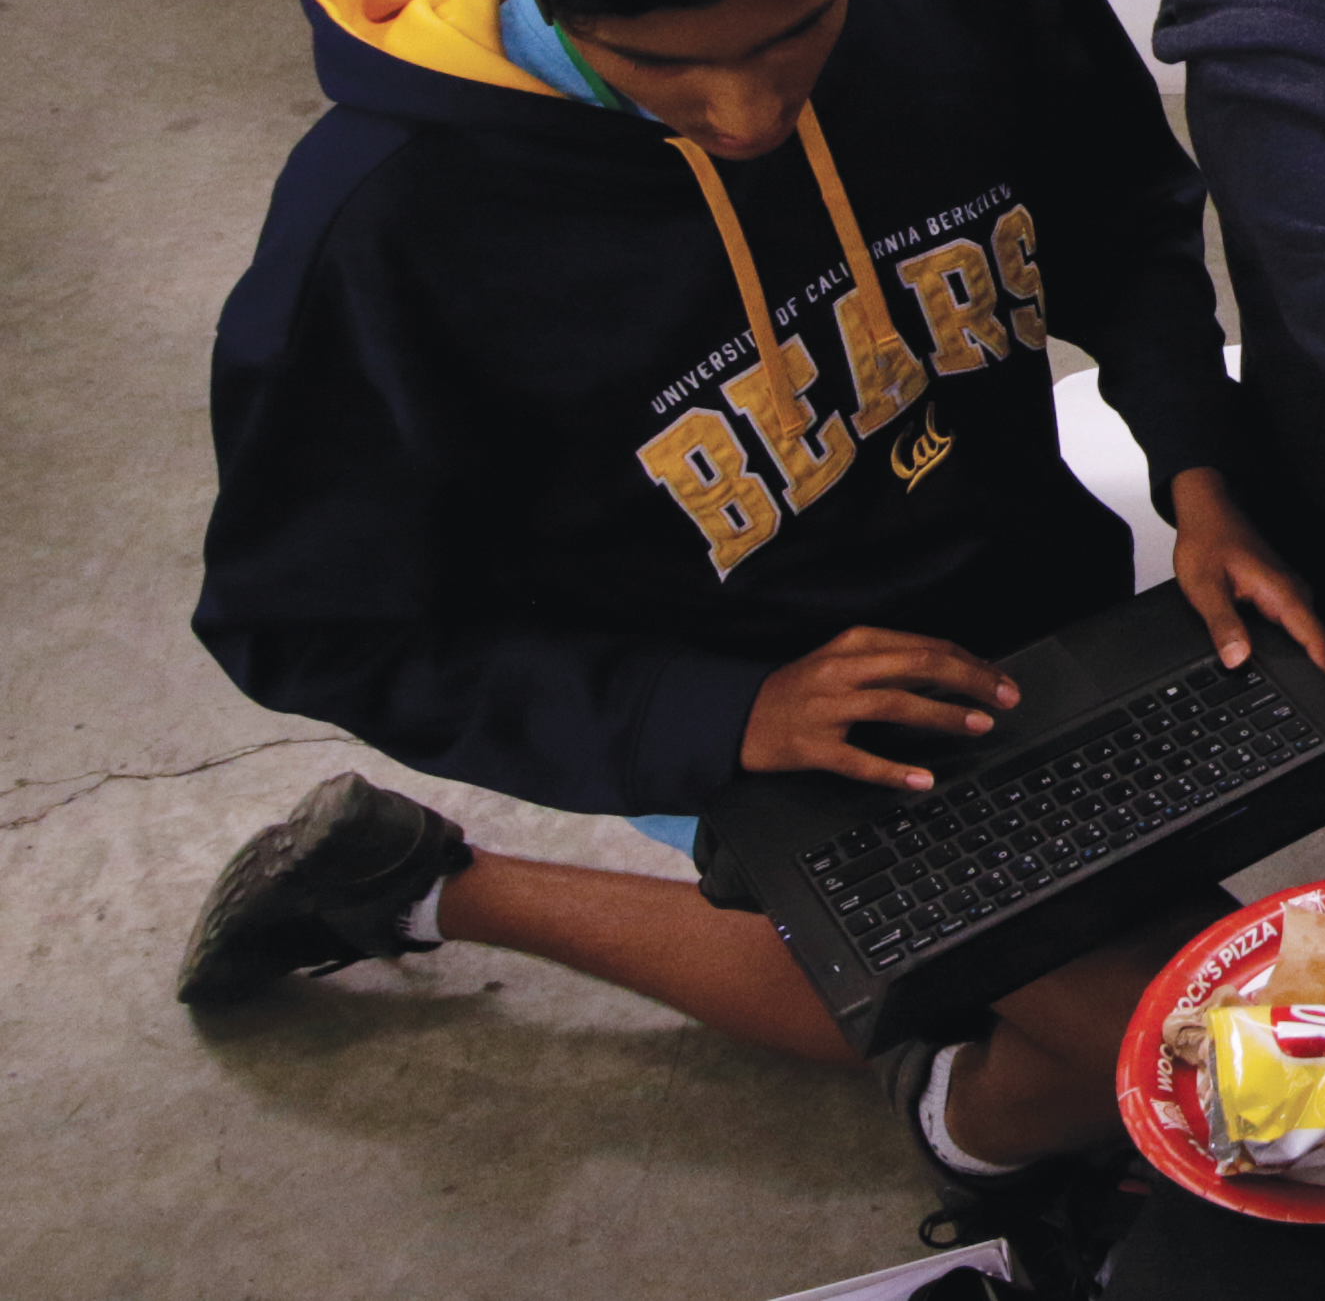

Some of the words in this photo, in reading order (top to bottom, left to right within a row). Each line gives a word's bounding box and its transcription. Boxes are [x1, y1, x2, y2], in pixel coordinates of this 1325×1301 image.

[651, 329, 758, 415] UNIVERSIT
[776, 297, 799, 327] OF
[805, 227, 921, 304] CALIRNIA
[635, 203, 1048, 585] BEARS
[890, 401, 957, 495] Cal
[1218, 920, 1278, 969] PIZZA
